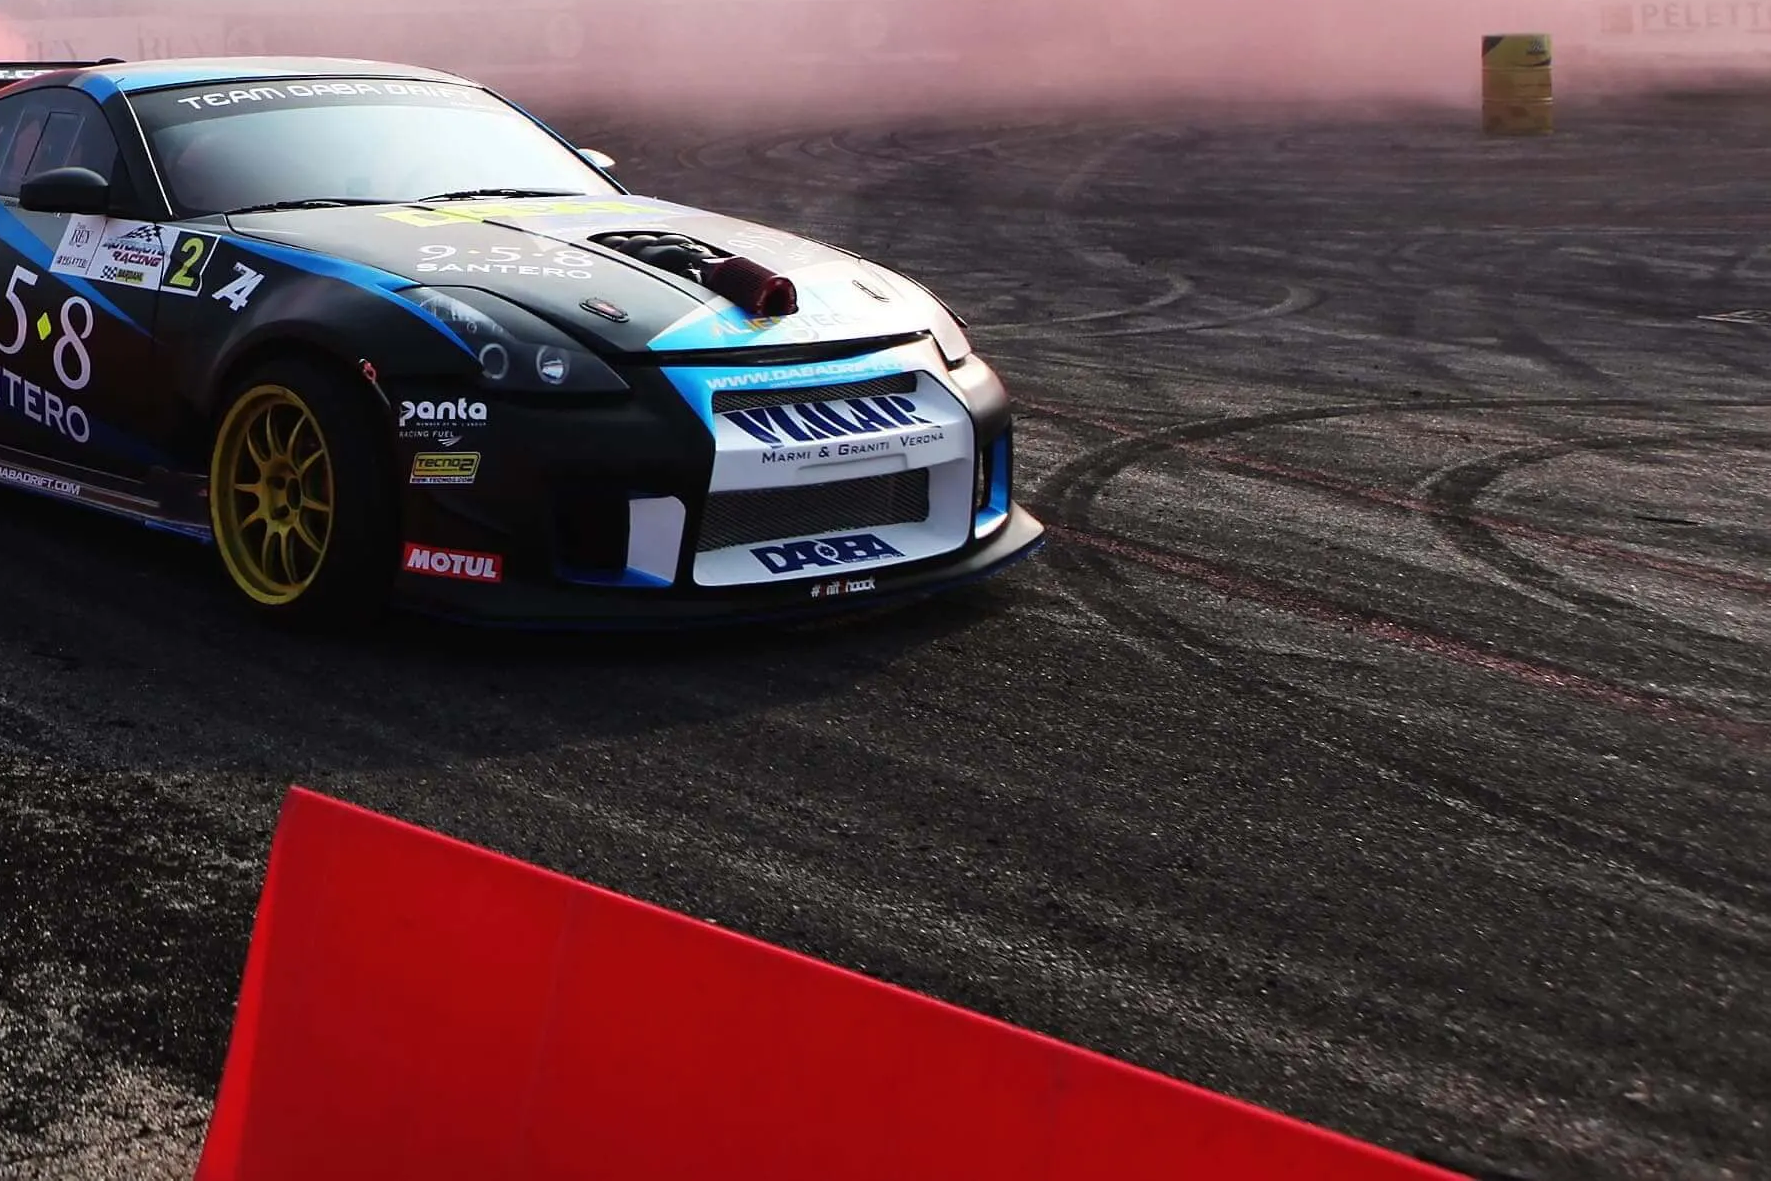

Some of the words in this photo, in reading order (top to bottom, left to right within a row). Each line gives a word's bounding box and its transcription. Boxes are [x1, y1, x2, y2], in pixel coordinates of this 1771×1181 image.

[1640, 1, 1771, 28] PELETT
[178, 87, 282, 110] TEAM
[113, 251, 162, 267] RACING
[170, 237, 204, 287] 2
[415, 263, 592, 279] SANTERO
[399, 398, 488, 427] panta
[818, 446, 830, 459] &
[407, 548, 497, 578] MOTUL
